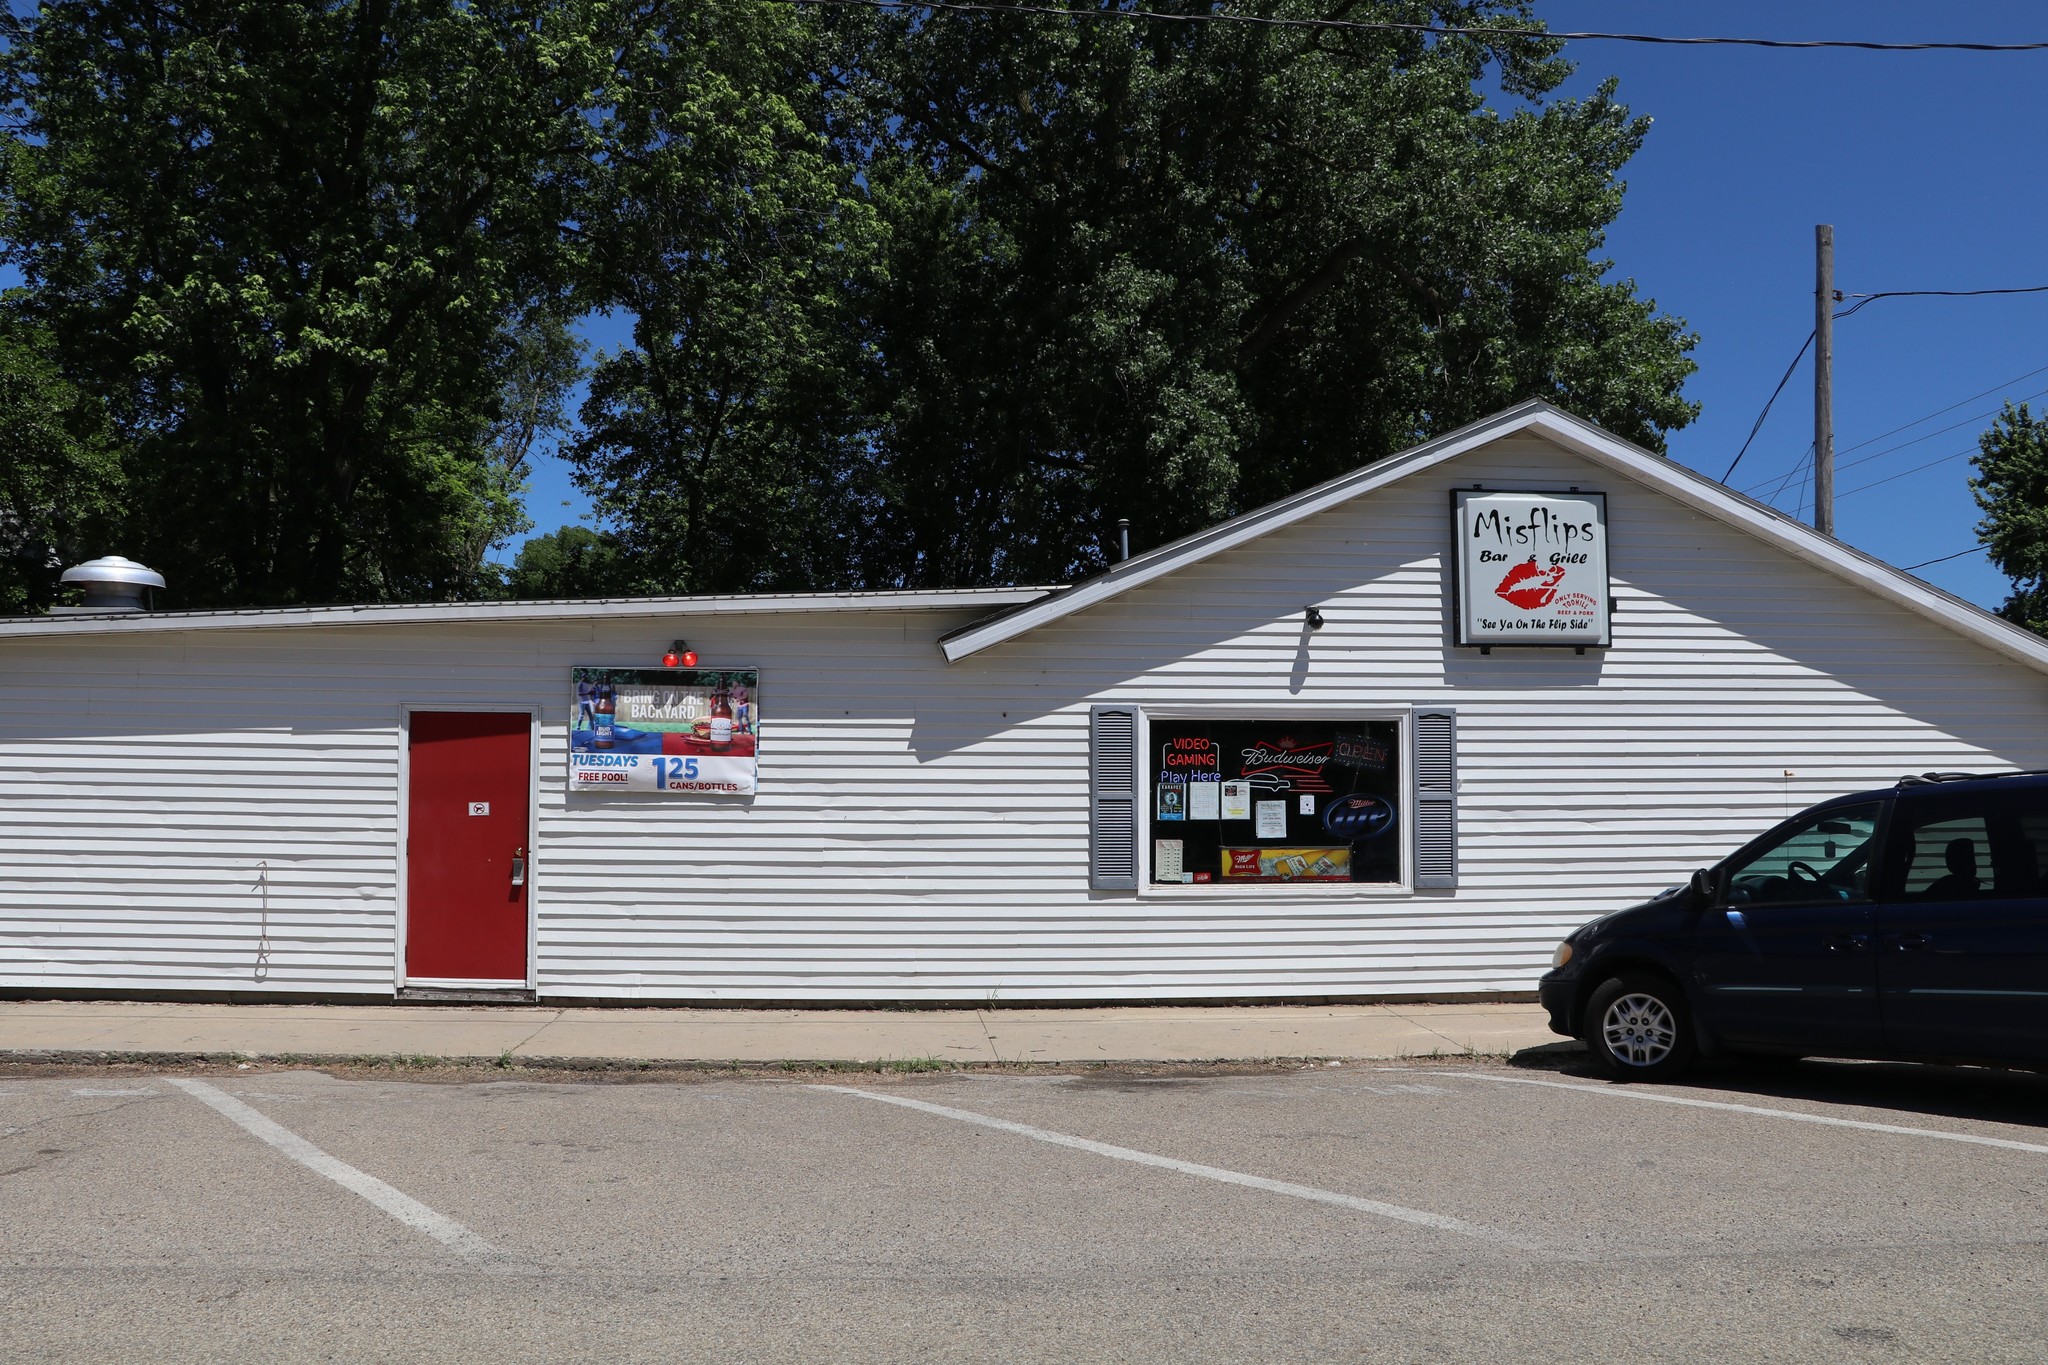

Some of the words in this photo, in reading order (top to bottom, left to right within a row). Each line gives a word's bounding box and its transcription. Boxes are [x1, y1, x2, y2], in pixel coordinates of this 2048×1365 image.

[1473, 507, 1594, 553] Misflips
[1479, 550, 1508, 563] Bar
[1527, 554, 1537, 563] &
[1549, 552, 1588, 566] Grill
[1555, 593, 1571, 605] ONLY
[1572, 592, 1598, 606] SERVING
[1499, 619, 1513, 631] Ya
[1515, 619, 1528, 630] On
[1531, 619, 1546, 630] The
[1548, 619, 1567, 631] Flip
[623, 689, 660, 705] BRING
[662, 690, 679, 705] ON
[683, 691, 704, 705] THE
[631, 704, 696, 720] BACKYARD
[1173, 738, 1210, 750] VIDEO
[1167, 753, 1216, 766] GAMING
[1241, 748, 1331, 765] Budweiser
[1338, 742, 1386, 763] OPEN
[572, 754, 639, 767] TUESDAYS
[578, 772, 600, 781] FREE
[601, 772, 628, 782] POOL!
[1160, 770, 1188, 784] Play
[1190, 769, 1222, 782] Here
[669, 782, 738, 791] CANS/BOTTLES
[1348, 798, 1376, 808] Miller
